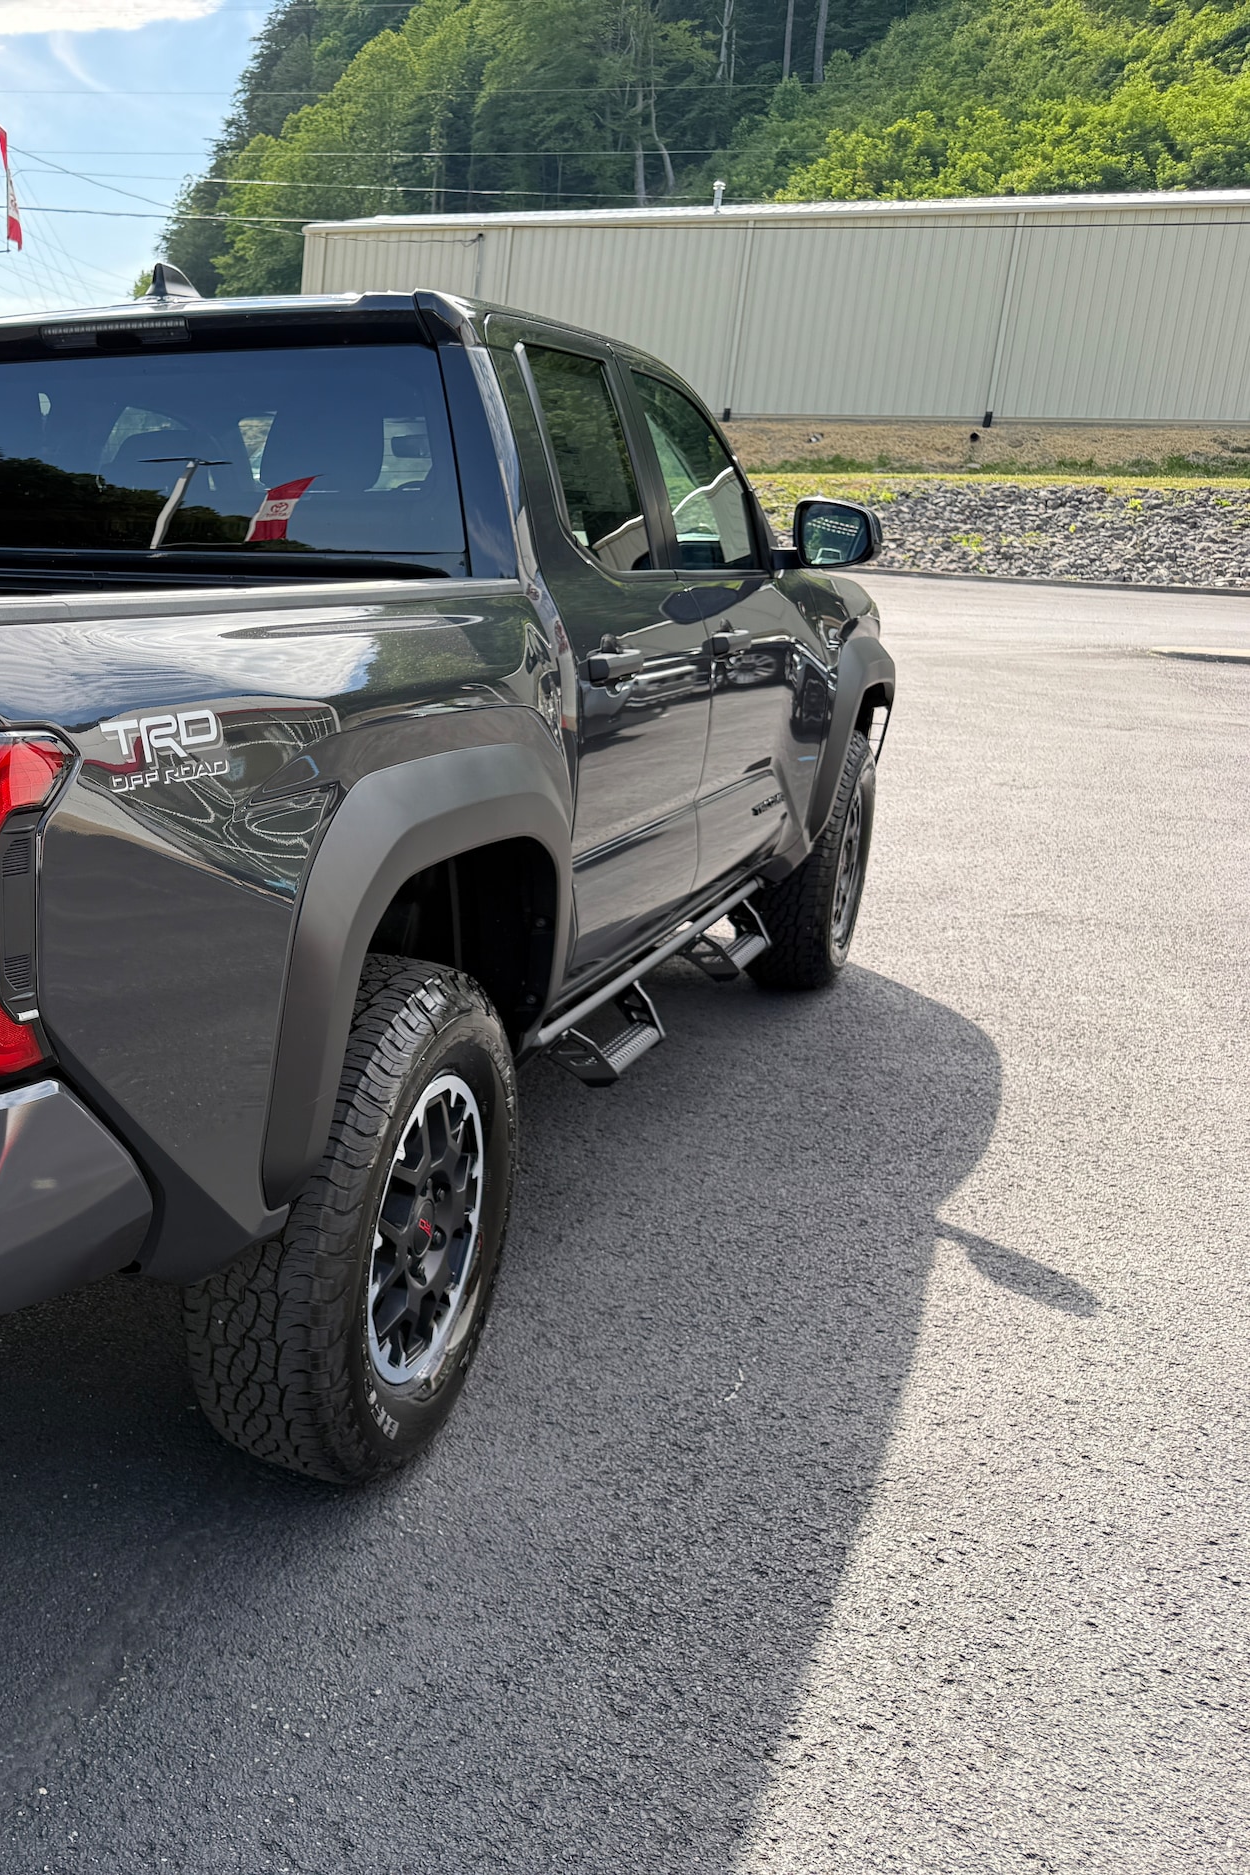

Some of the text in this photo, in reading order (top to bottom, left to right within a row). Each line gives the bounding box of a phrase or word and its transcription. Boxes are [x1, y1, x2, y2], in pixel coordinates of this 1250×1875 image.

[100, 709, 218, 763] TRD
[109, 758, 230, 793] OFF ROAD
